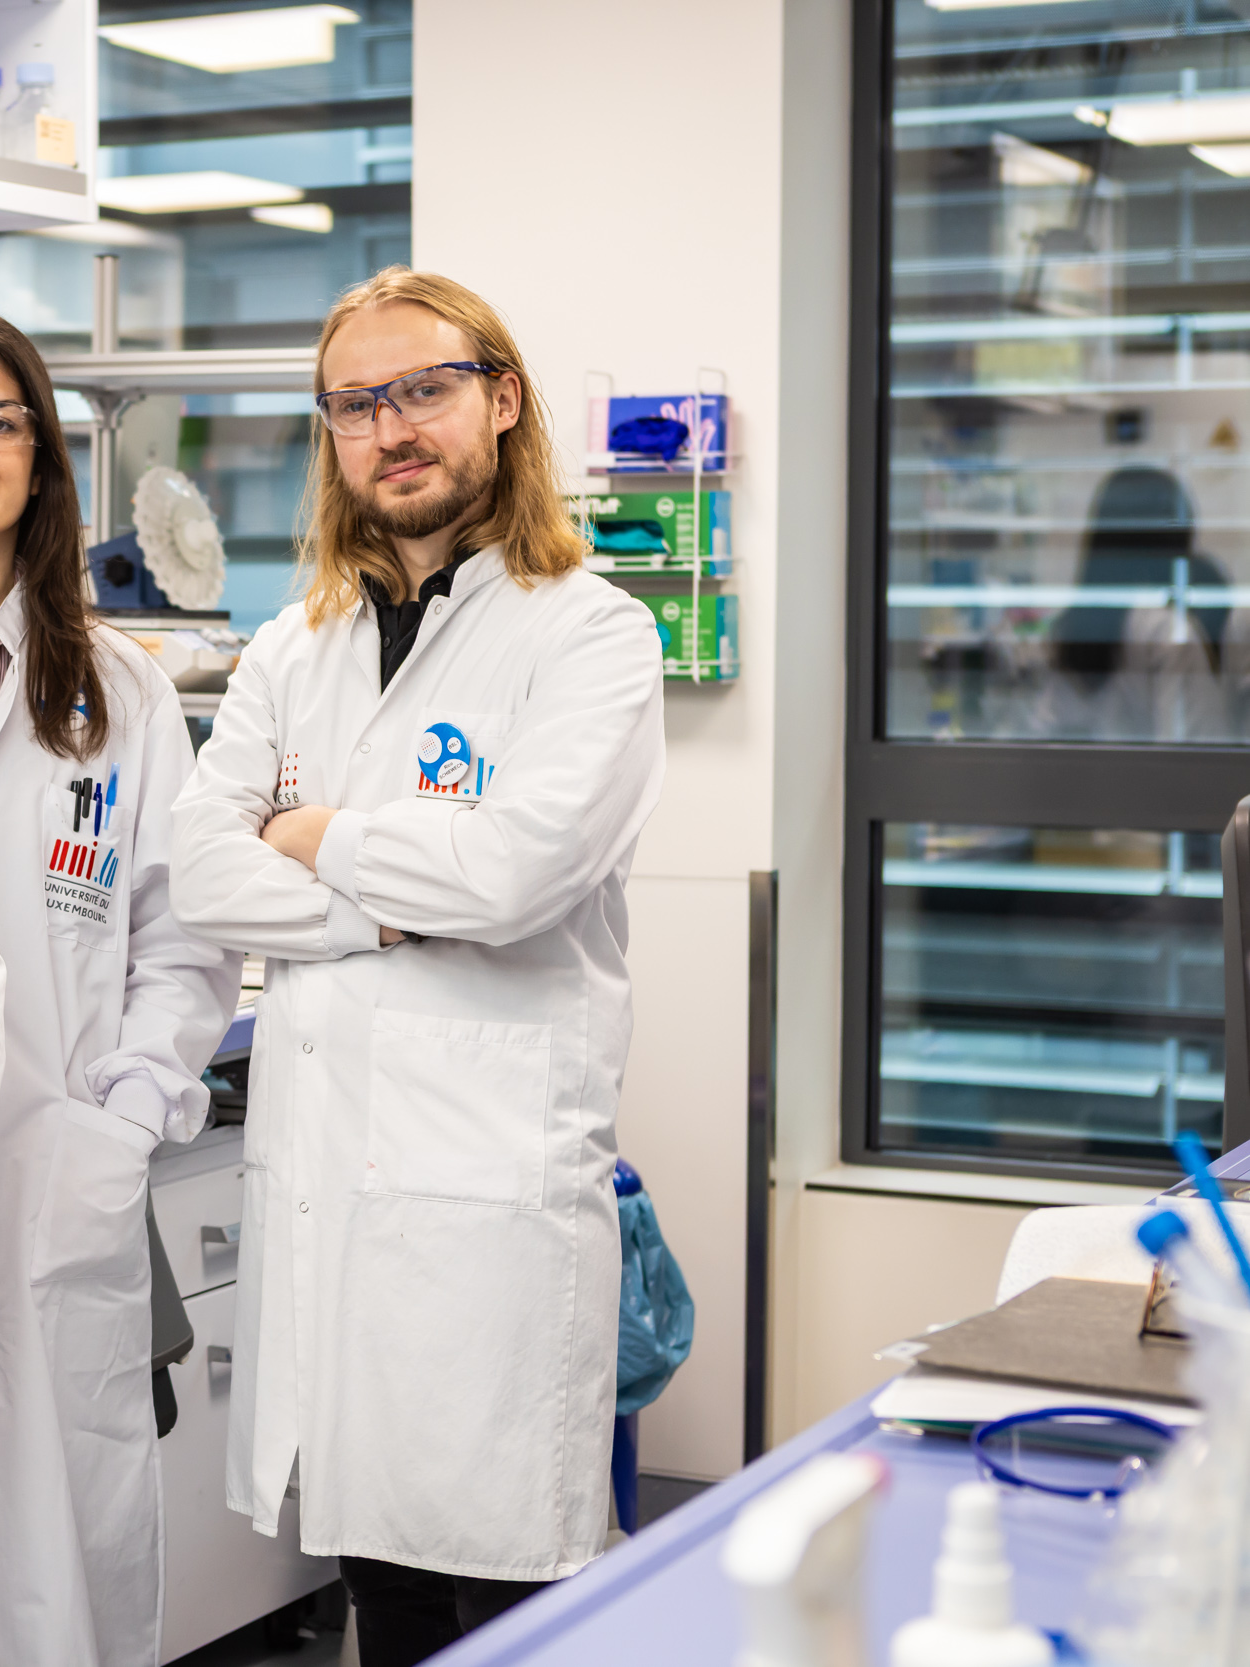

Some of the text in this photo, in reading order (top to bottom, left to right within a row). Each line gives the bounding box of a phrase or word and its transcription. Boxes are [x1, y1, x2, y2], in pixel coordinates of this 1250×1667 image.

[448, 740, 460, 750] BSL1
[277, 791, 300, 806] CSB
[45, 881, 110, 910] UNIVERSITÉ DU
[46, 898, 107, 924] UXEMBOURG
